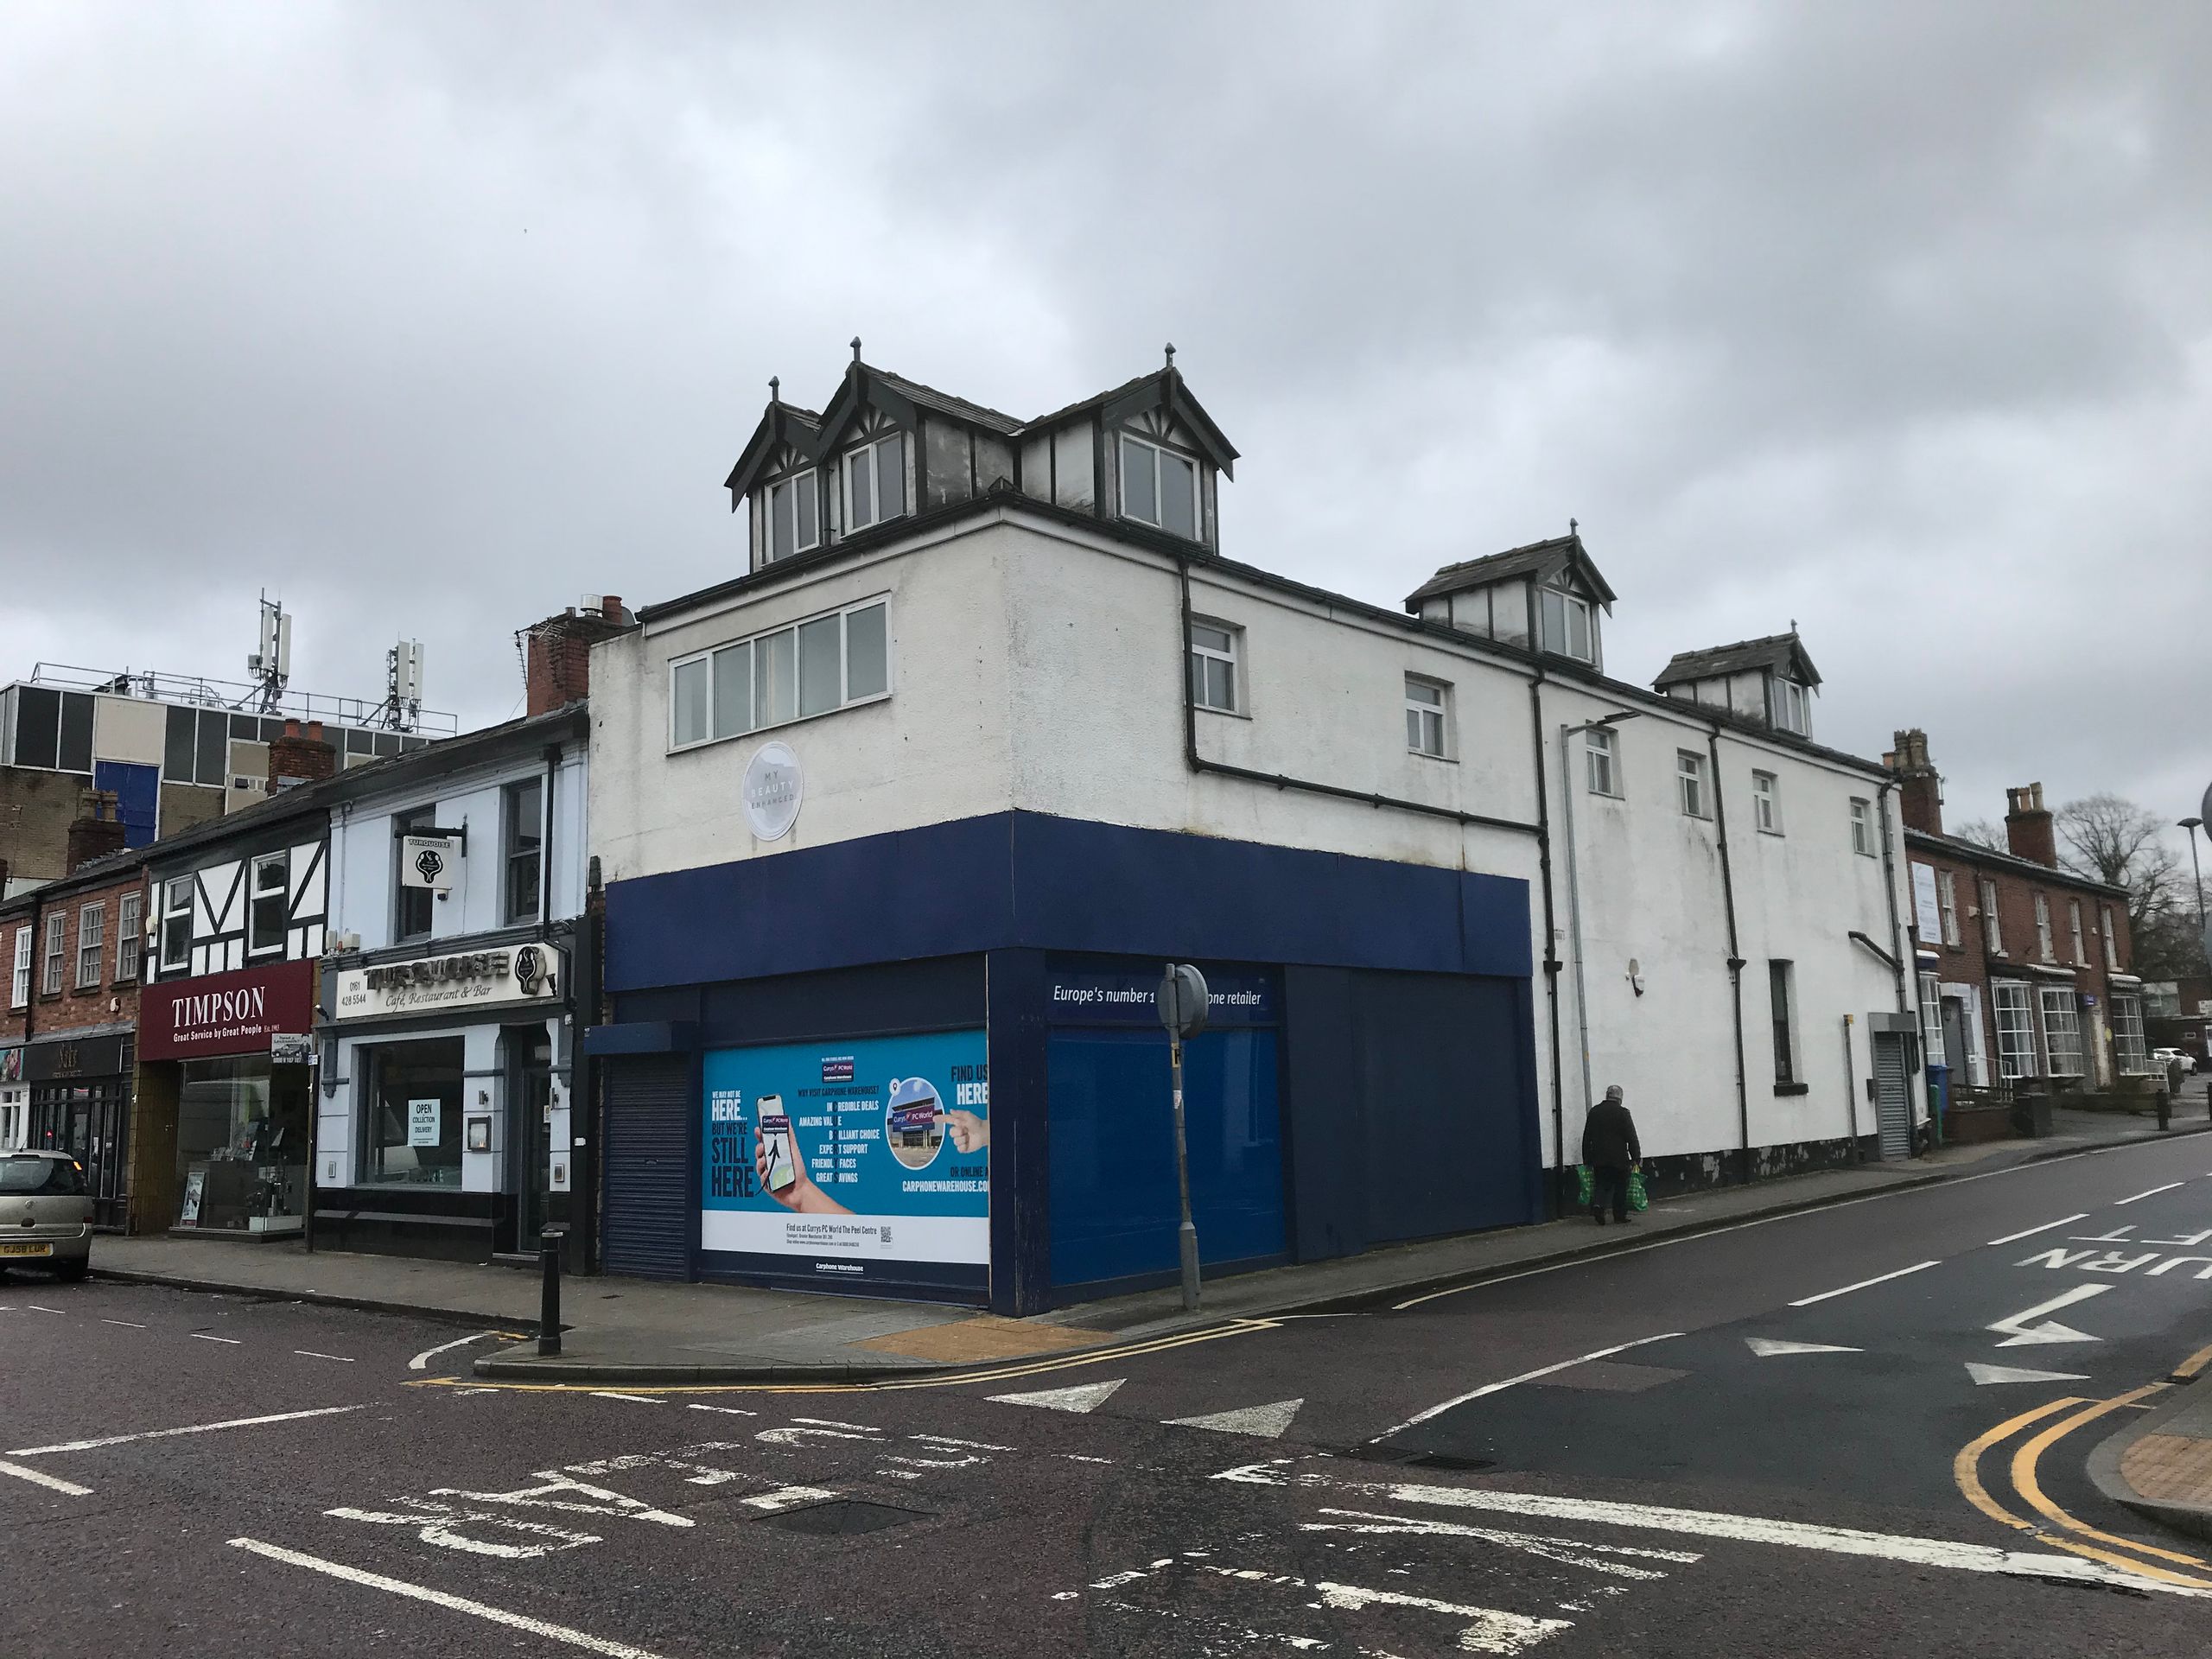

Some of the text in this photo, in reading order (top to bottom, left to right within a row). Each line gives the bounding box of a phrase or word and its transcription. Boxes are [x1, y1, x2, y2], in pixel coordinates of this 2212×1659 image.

[765, 770, 778, 781] MY
[751, 780, 794, 798] BEAUTY
[751, 794, 794, 809] ENHANCED
[408, 838, 451, 849] TURQUOISE
[349, 982, 360, 991] 0161
[341, 994, 366, 1006] 428 5544
[409, 986, 460, 1006] Restaurant
[474, 985, 492, 996] Bar
[1053, 985, 1262, 1005] Europe's number 1 one retailer
[172, 986, 265, 1028] TIMPSON
[174, 1032, 189, 1042] Great
[191, 1029, 213, 1040] Service
[213, 1029, 221, 1039] by
[222, 1027, 239, 1037] Great
[241, 1023, 262, 1035] People
[951, 1065, 988, 1082] FIND US
[957, 1083, 988, 1105] HERE
[416, 1104, 432, 1114] OPEN
[861, 1100, 880, 1110] DEALS
[912, 1112, 919, 1121] PC
[919, 1109, 933, 1120] World
[799, 1116, 823, 1127] AMAZING
[712, 1122, 747, 1135] BUT WE'RE
[859, 1128, 880, 1140] CHOICE
[711, 1137, 748, 1164] STILL
[842, 1143, 868, 1154] SUPPORT
[839, 1158, 857, 1168] FACES
[816, 1172, 834, 1183] GREAT
[950, 1168, 959, 1177] OR
[961, 1167, 983, 1178] ONLINE
[711, 1166, 754, 1198] HERE
[786, 1224, 796, 1232] Find
[802, 1224, 807, 1233] at
[807, 1224, 822, 1234] Currys
[822, 1224, 828, 1233] PC
[829, 1225, 842, 1234] World
[842, 1225, 850, 1235] The
[851, 1226, 861, 1235] Peel
[861, 1226, 877, 1235] Centre
